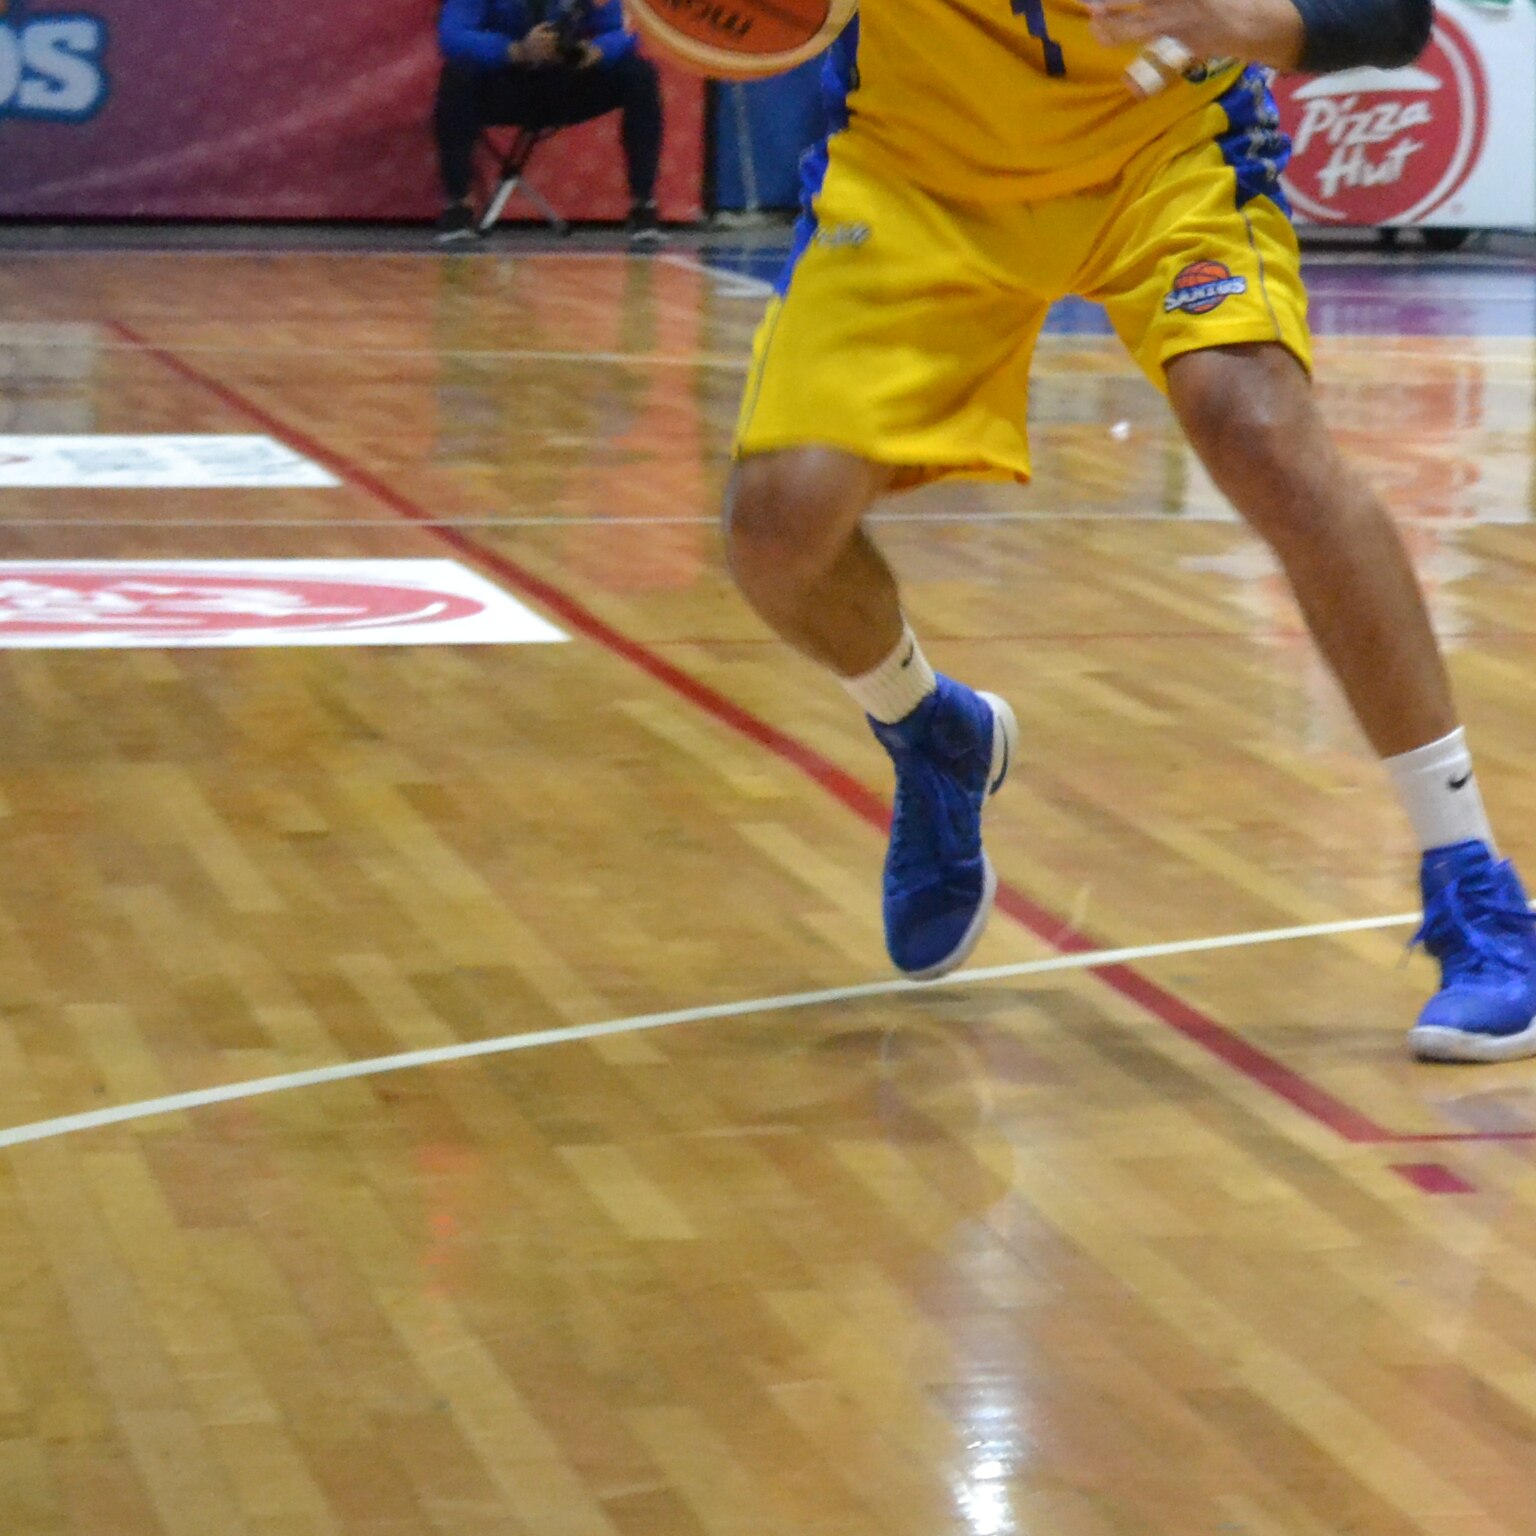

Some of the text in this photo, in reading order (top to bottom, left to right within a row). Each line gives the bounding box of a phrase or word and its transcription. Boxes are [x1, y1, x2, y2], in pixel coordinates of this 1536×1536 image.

[1292, 94, 1433, 157] Pizza
[1314, 136, 1426, 200] Hut
[1163, 275, 1248, 314] SANTOS
